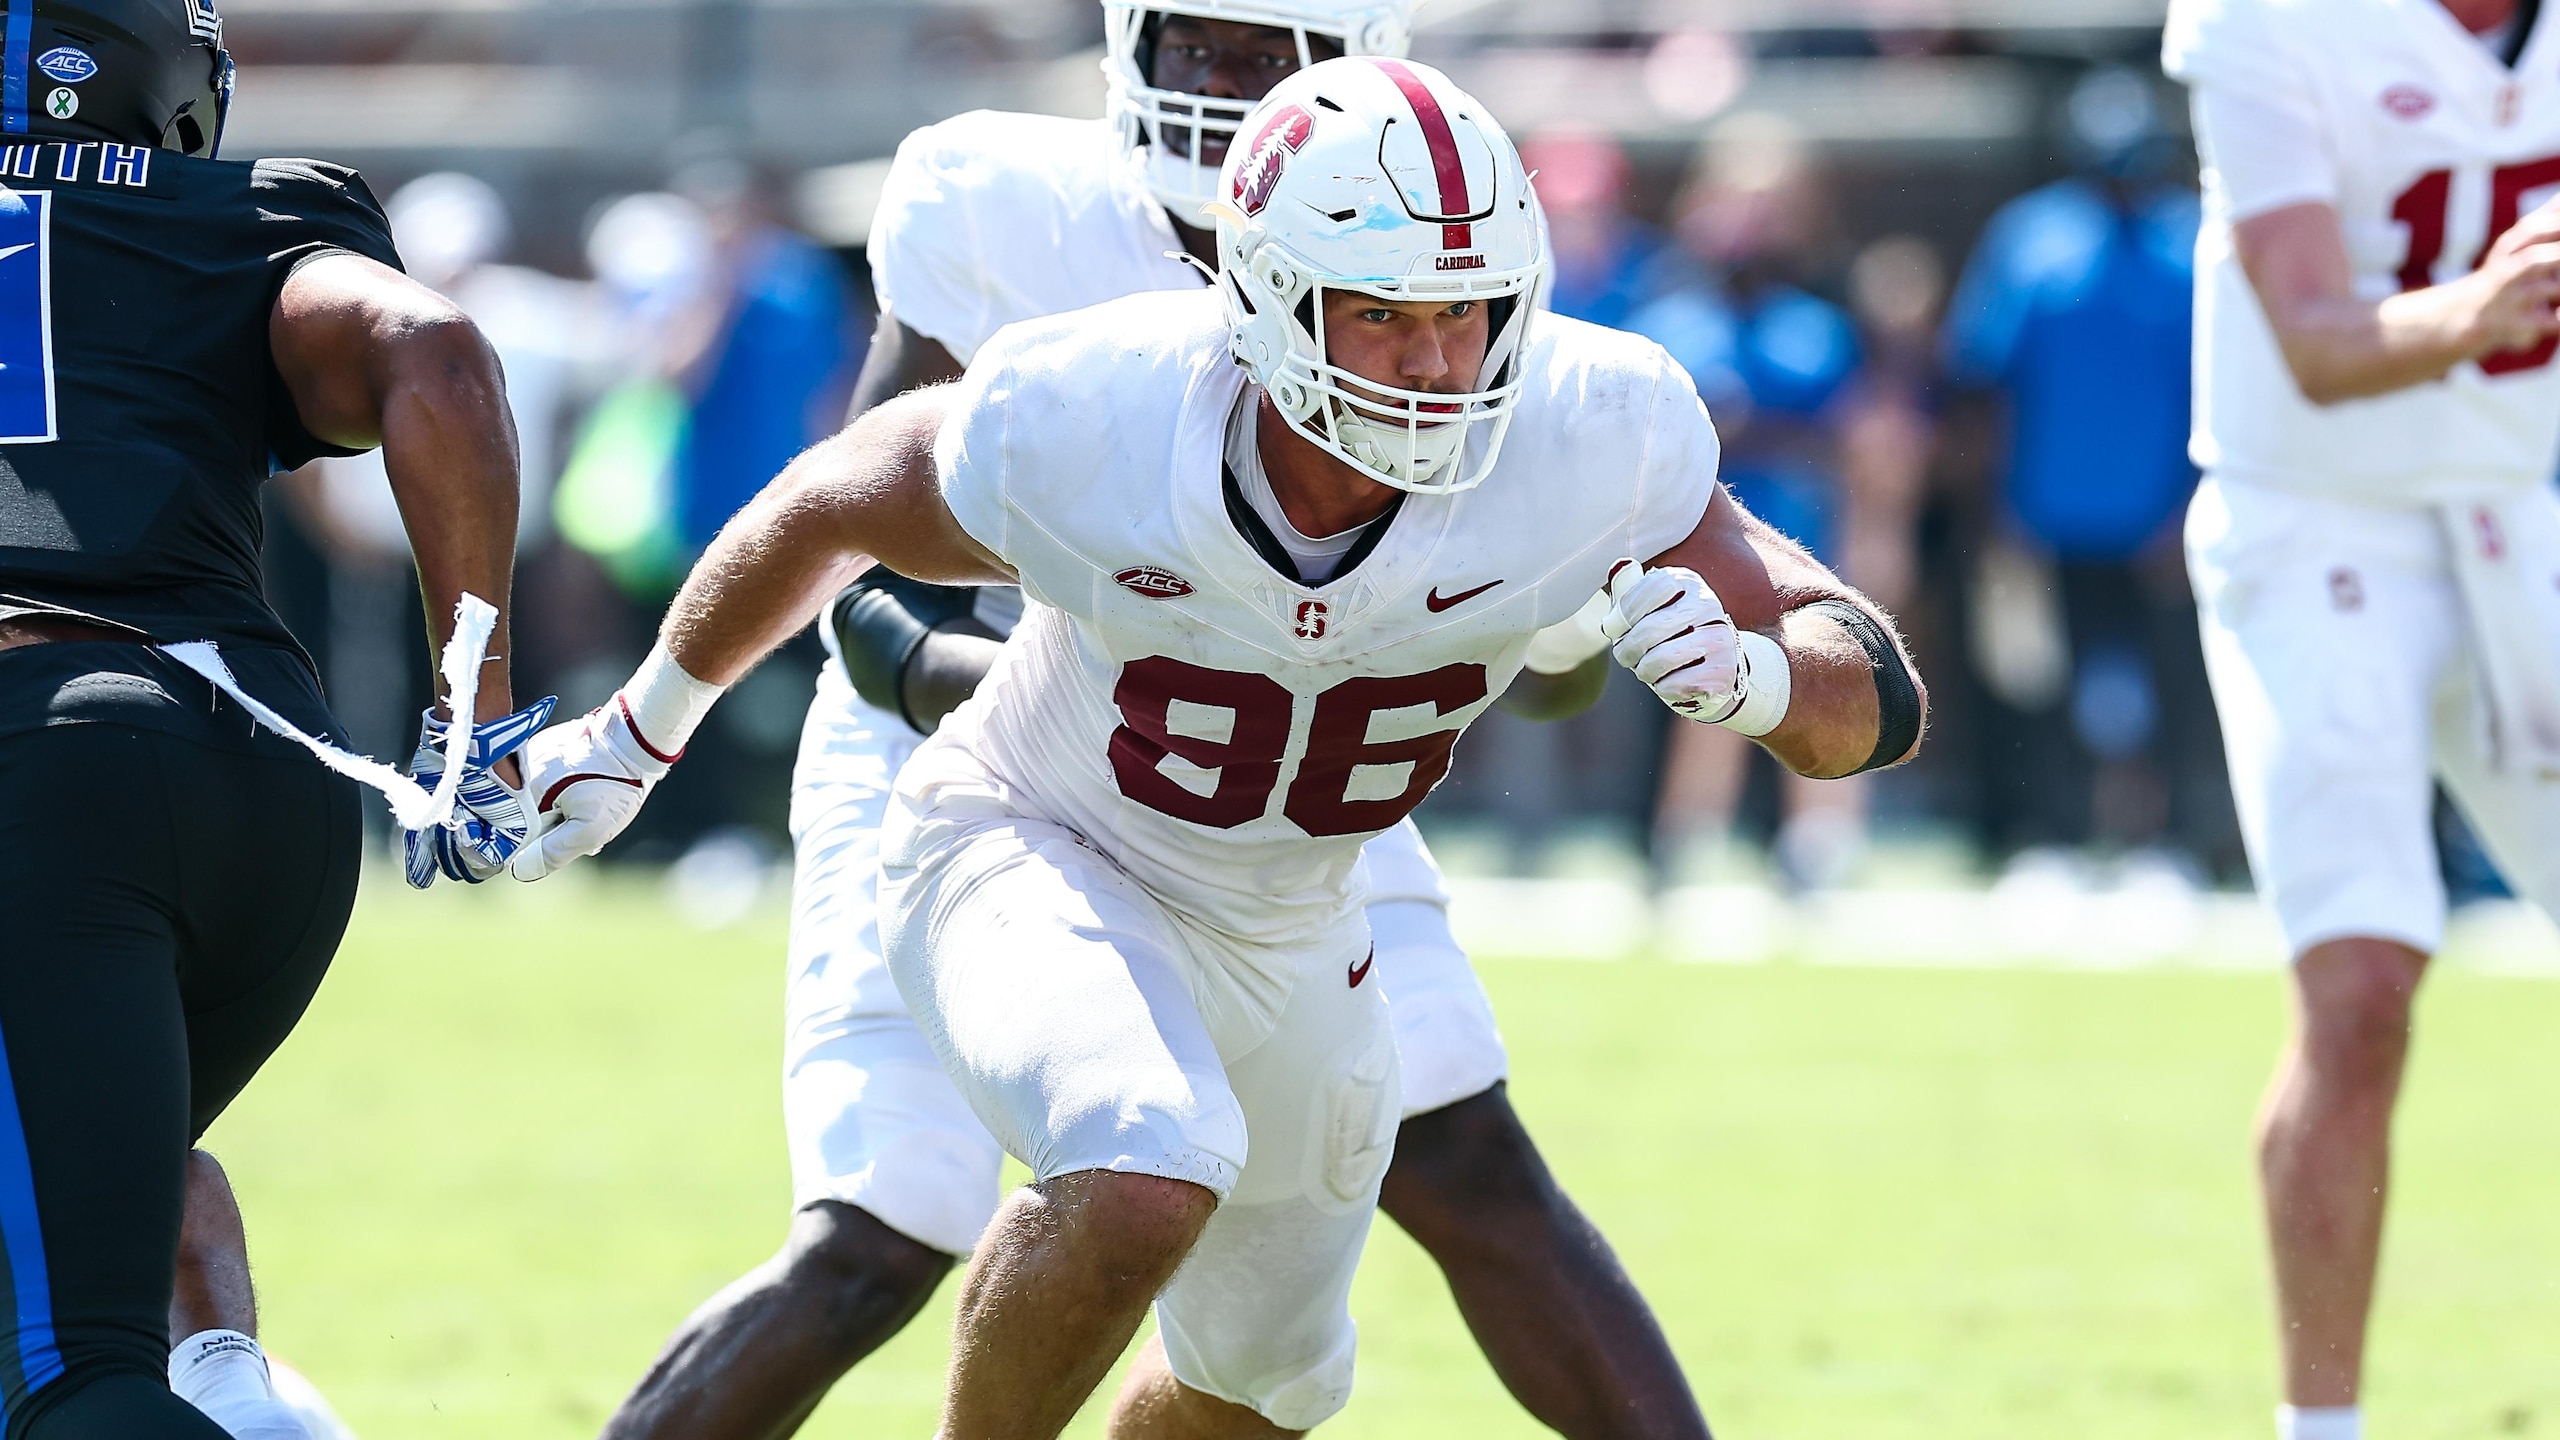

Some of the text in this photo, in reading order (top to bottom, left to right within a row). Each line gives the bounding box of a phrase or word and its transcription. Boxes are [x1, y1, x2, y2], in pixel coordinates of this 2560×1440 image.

[46, 56, 91, 72] ACC
[1435, 254, 1486, 271] CARDINAL
[1124, 573, 1185, 592] ACC
[1107, 654, 1488, 838] 86
